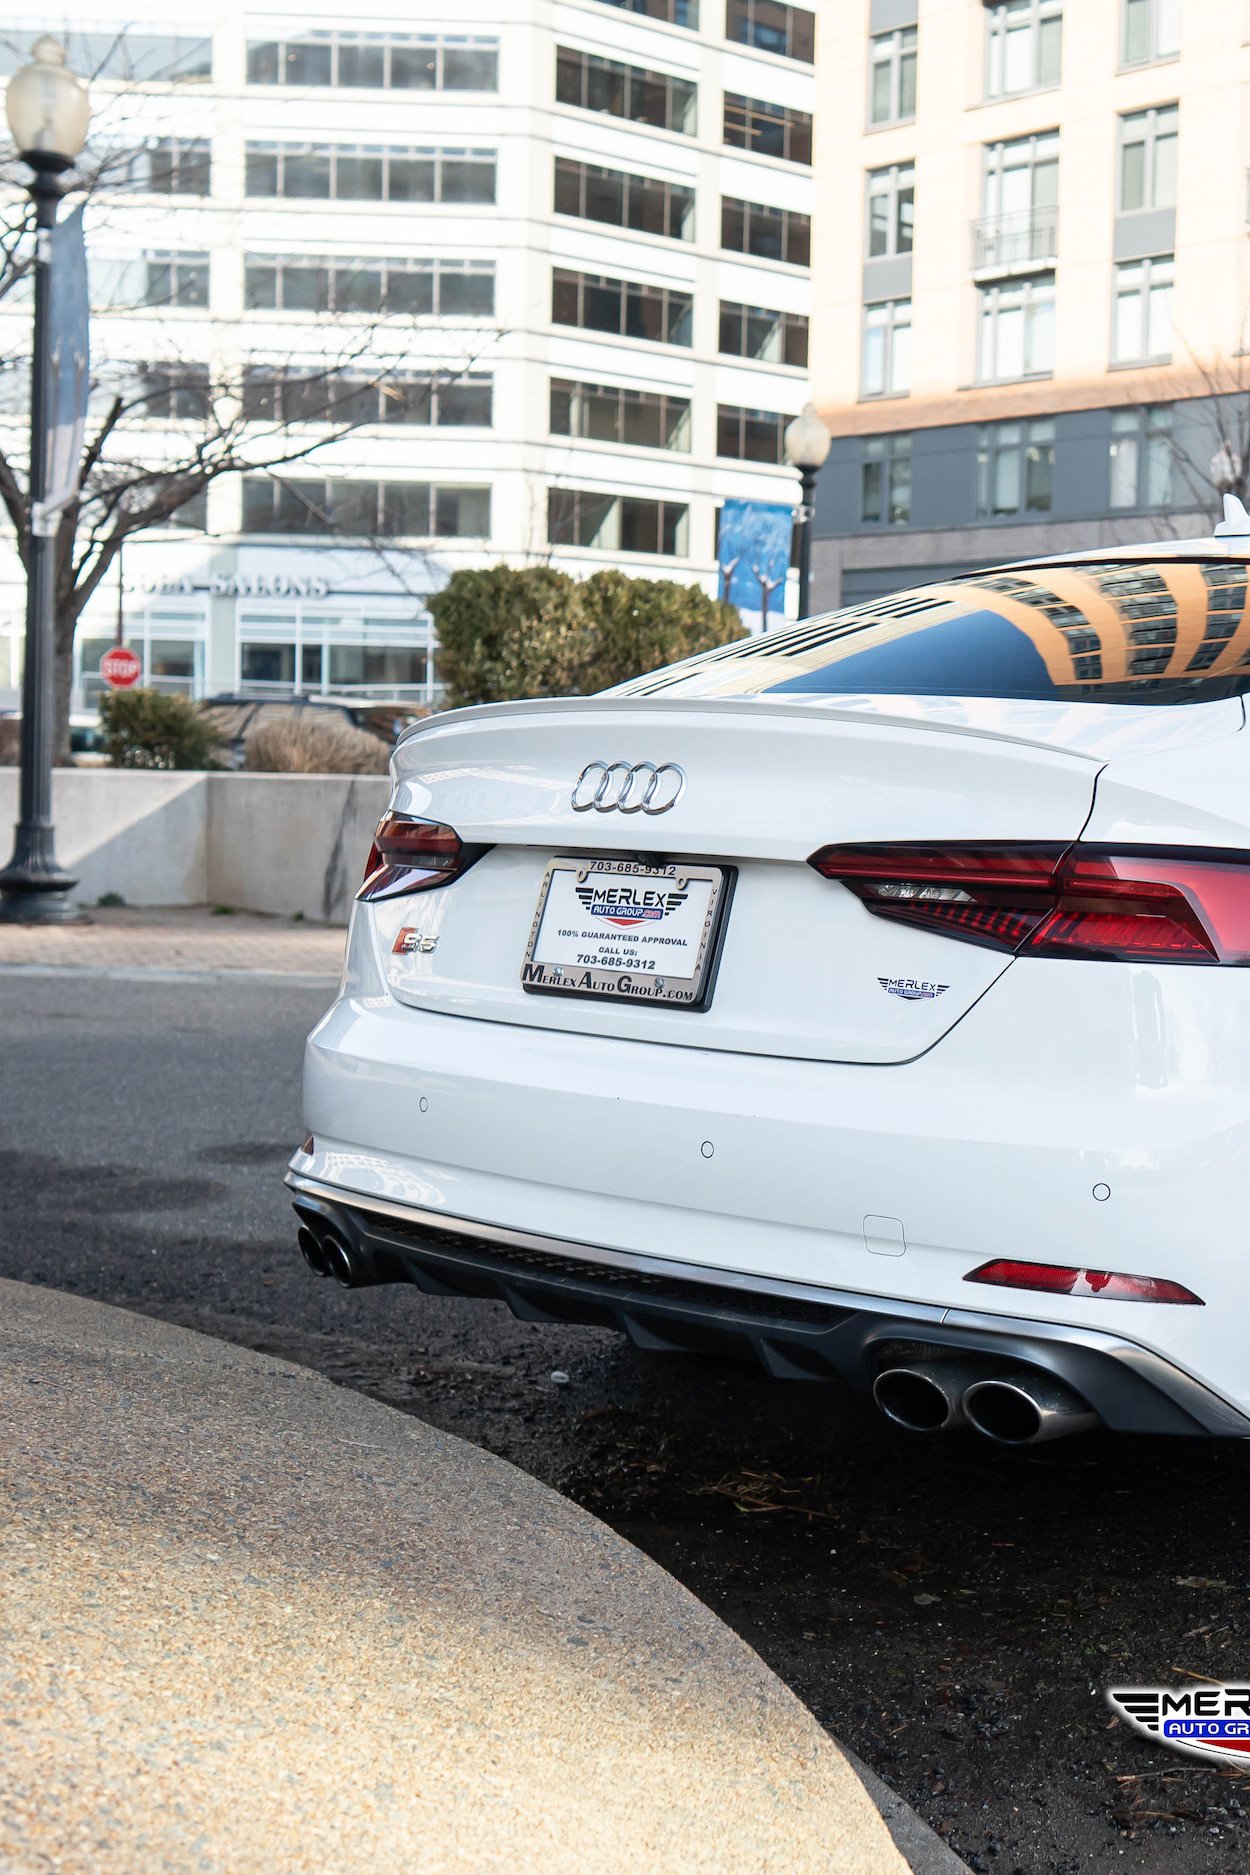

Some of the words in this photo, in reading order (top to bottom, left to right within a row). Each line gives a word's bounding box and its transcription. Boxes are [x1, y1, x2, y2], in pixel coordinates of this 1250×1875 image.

[103, 658, 137, 677] STOP
[593, 888, 667, 908] MERLEX
[523, 871, 550, 958] ARLINGTON
[593, 905, 615, 915] AUTO
[557, 929, 579, 939] 100%
[581, 931, 639, 943] GUARANTEED
[641, 936, 688, 947] APPROVAL
[694, 888, 718, 972] VIRGINIA
[399, 931, 440, 954] S5
[598, 946, 620, 955] CALL
[576, 954, 656, 970] 703-685-9312
[889, 979, 936, 991] MERLEX
